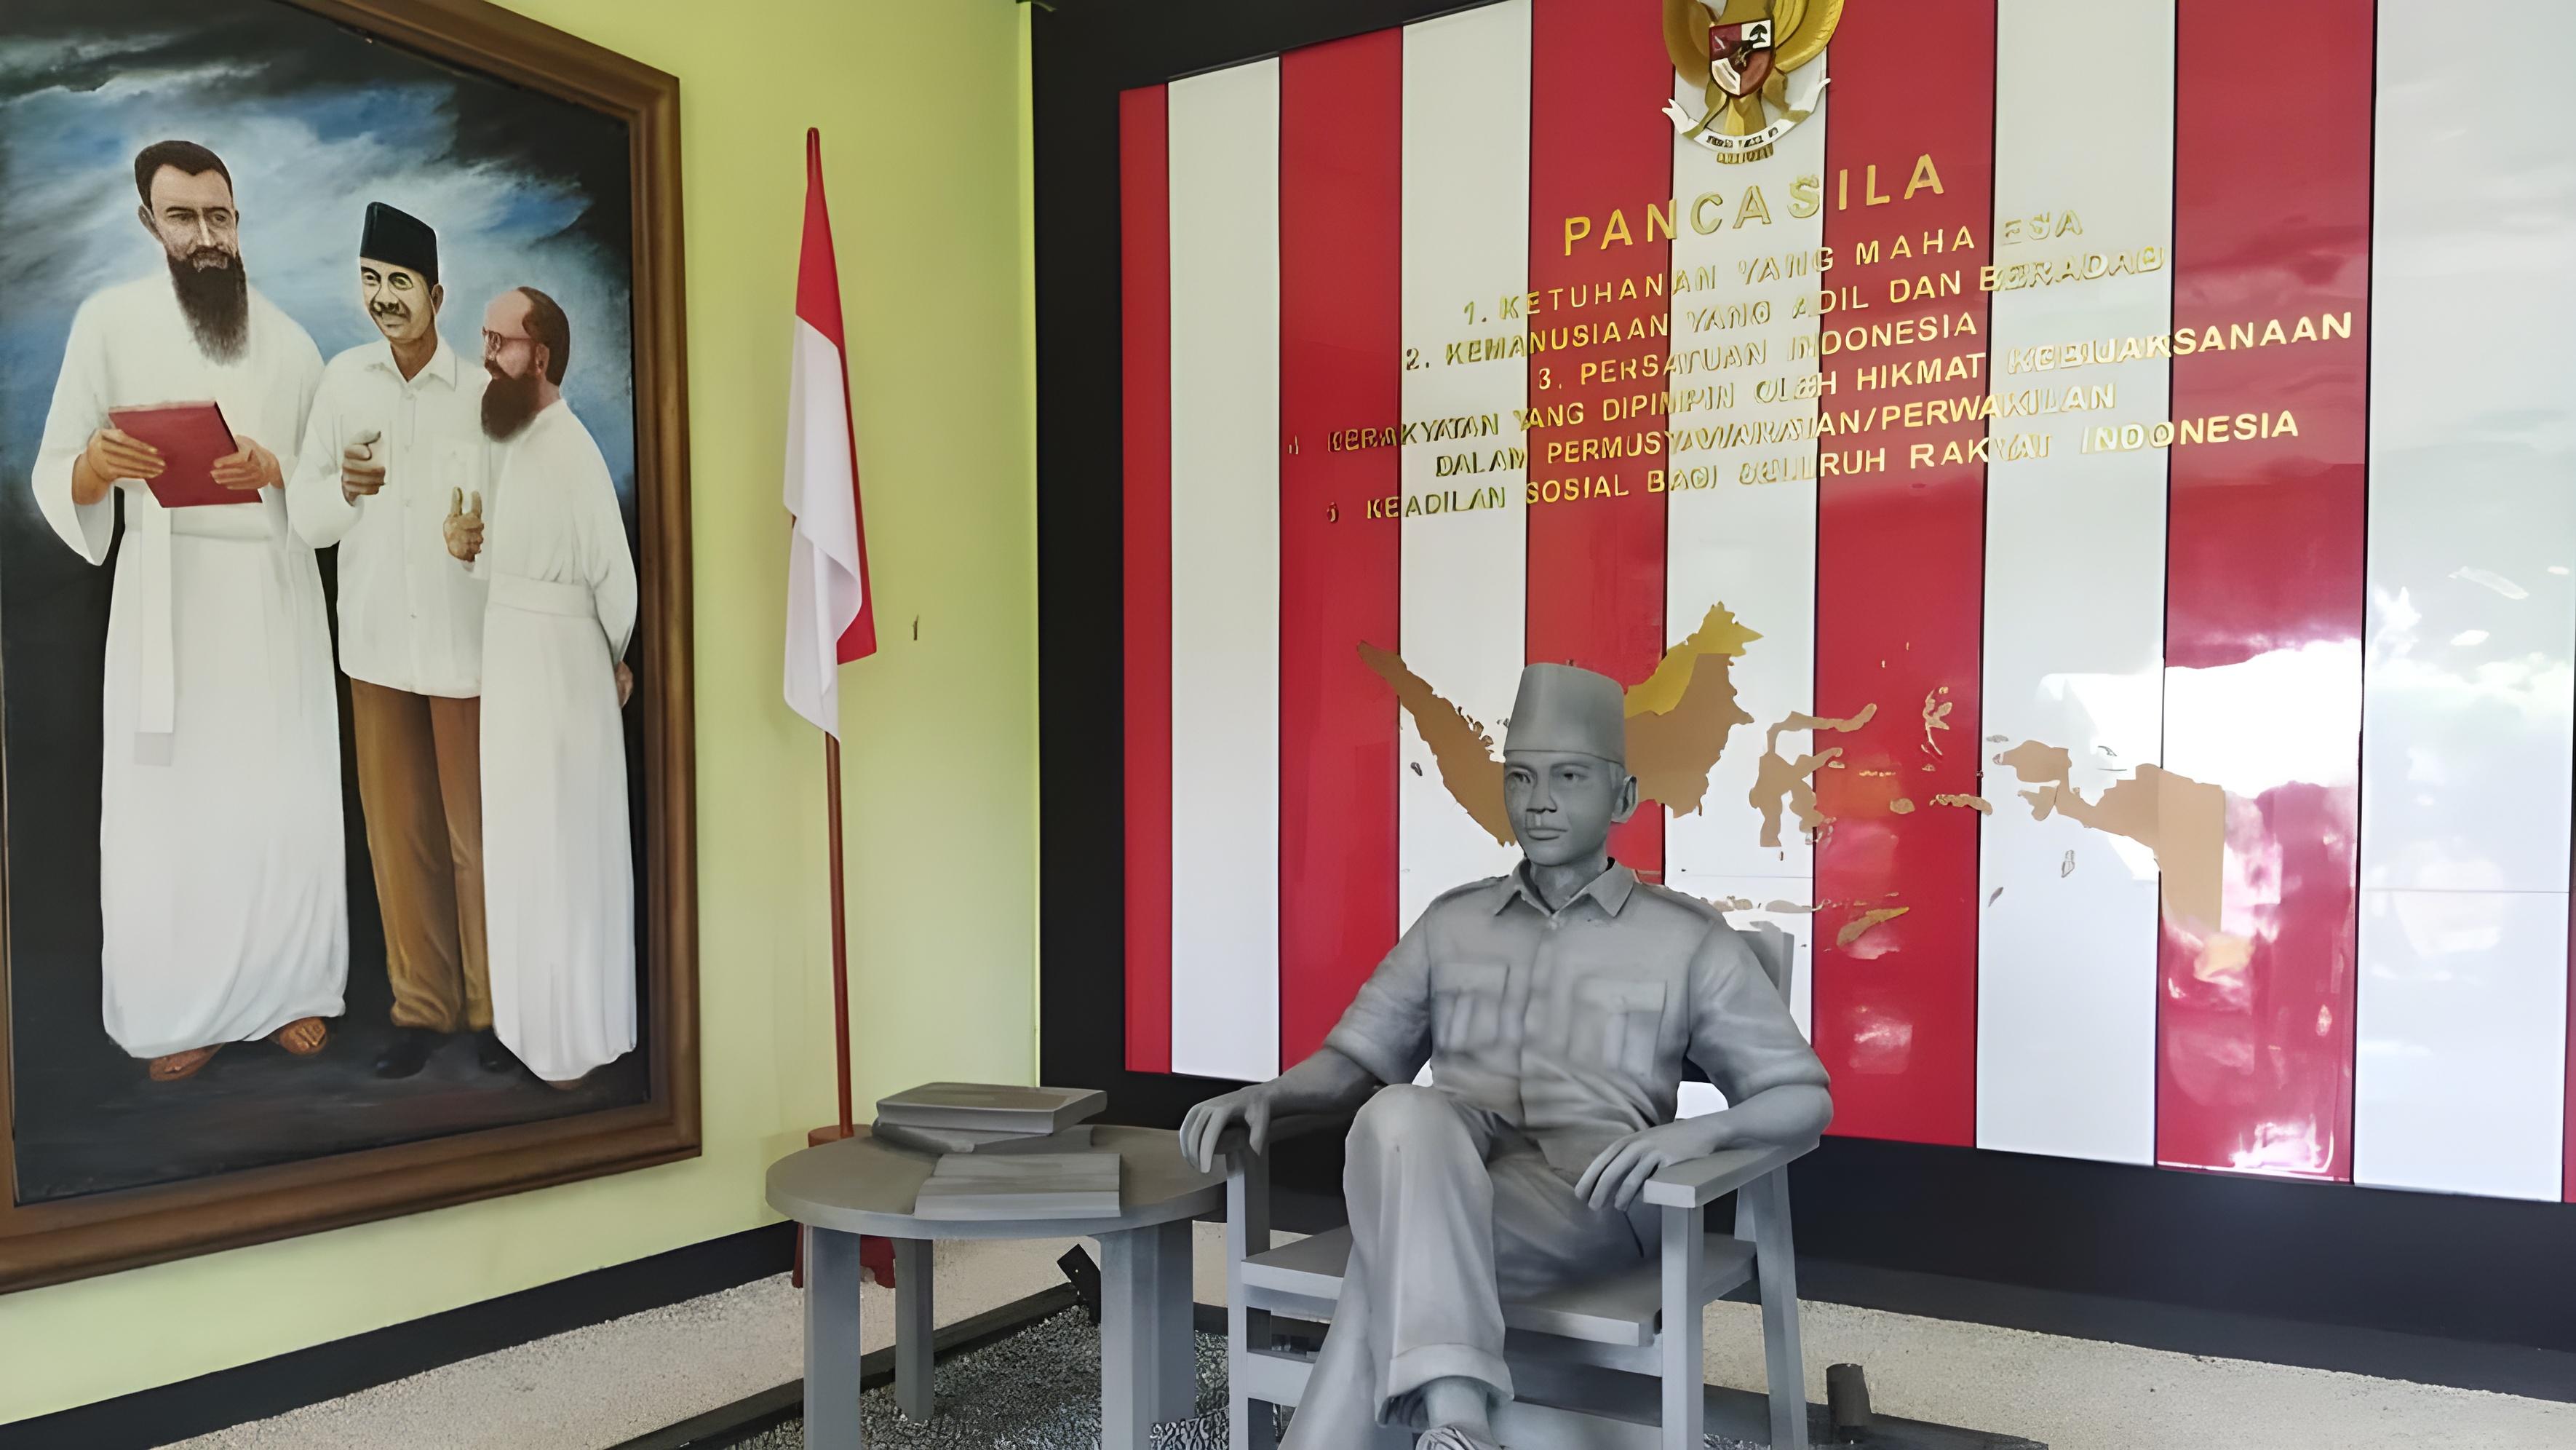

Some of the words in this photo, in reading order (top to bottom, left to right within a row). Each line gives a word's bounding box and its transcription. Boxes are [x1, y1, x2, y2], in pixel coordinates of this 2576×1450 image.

[1565, 154, 1944, 255] PANCASILA
[1406, 347, 1430, 371] 2.
[1445, 312, 1669, 366] KEMANUSIAAN
[1889, 269, 1961, 304] DAN
[1463, 301, 1487, 325] 1.
[1498, 264, 1716, 320] KETUHANAN
[1737, 247, 1834, 285] YANG
[1856, 226, 1975, 266] MAHA
[1513, 401, 1584, 432] YANG
[1856, 352, 1987, 392] HIKMAT
[1538, 367, 1562, 390] 3.
[1787, 312, 1978, 362] INDONESIA
[1366, 486, 1506, 520] KEADILAN
[1525, 473, 1630, 505] SOSIAL
[2080, 409, 2299, 454] INDONESIA
[1435, 447, 1525, 478] DALAM
